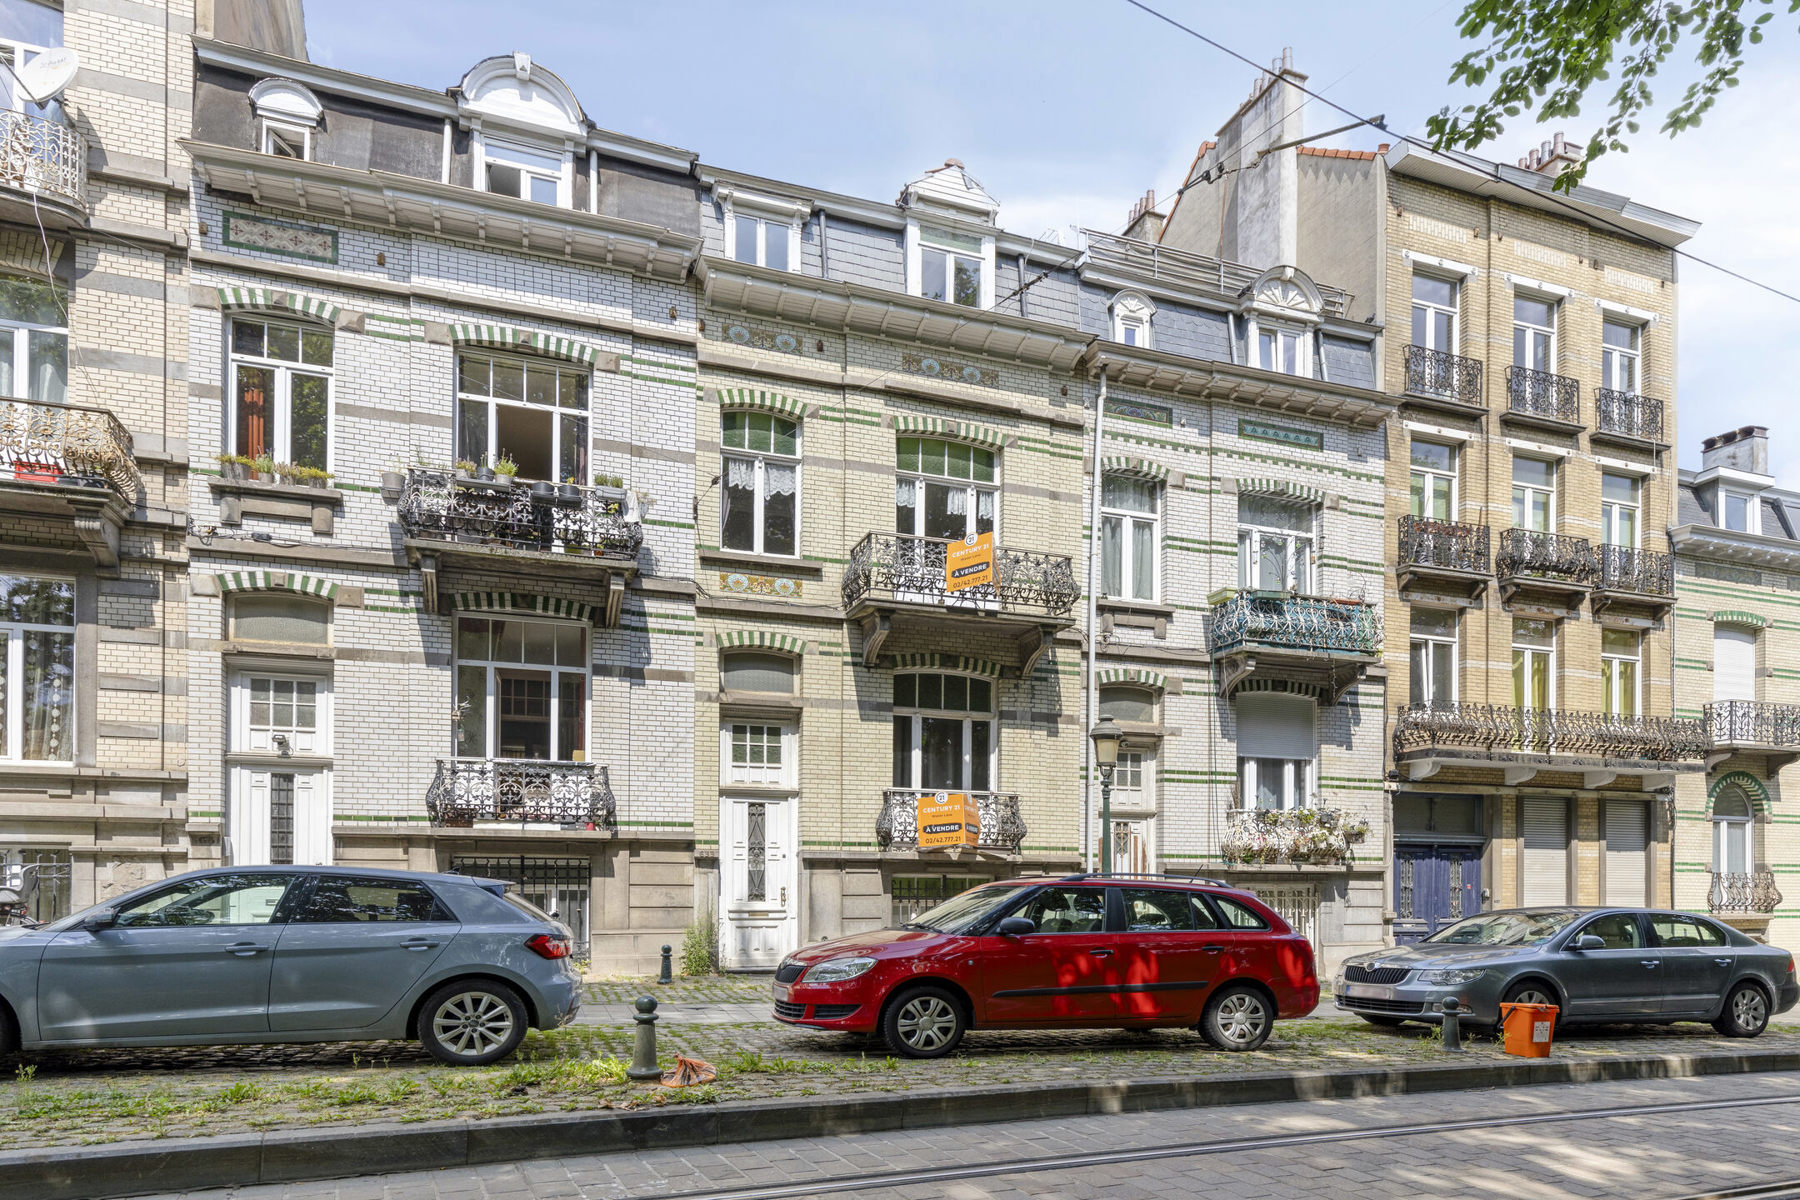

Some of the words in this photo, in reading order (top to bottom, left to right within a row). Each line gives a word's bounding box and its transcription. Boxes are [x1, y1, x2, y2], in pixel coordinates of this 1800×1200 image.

[952, 545, 982, 558] CENTURY
[960, 563, 987, 575] VENDRE
[953, 575, 988, 588] 02/42.777.21
[922, 805, 952, 813] CENTURY
[932, 824, 960, 832] VENDRE
[925, 836, 961, 844] 02/42.777.21
